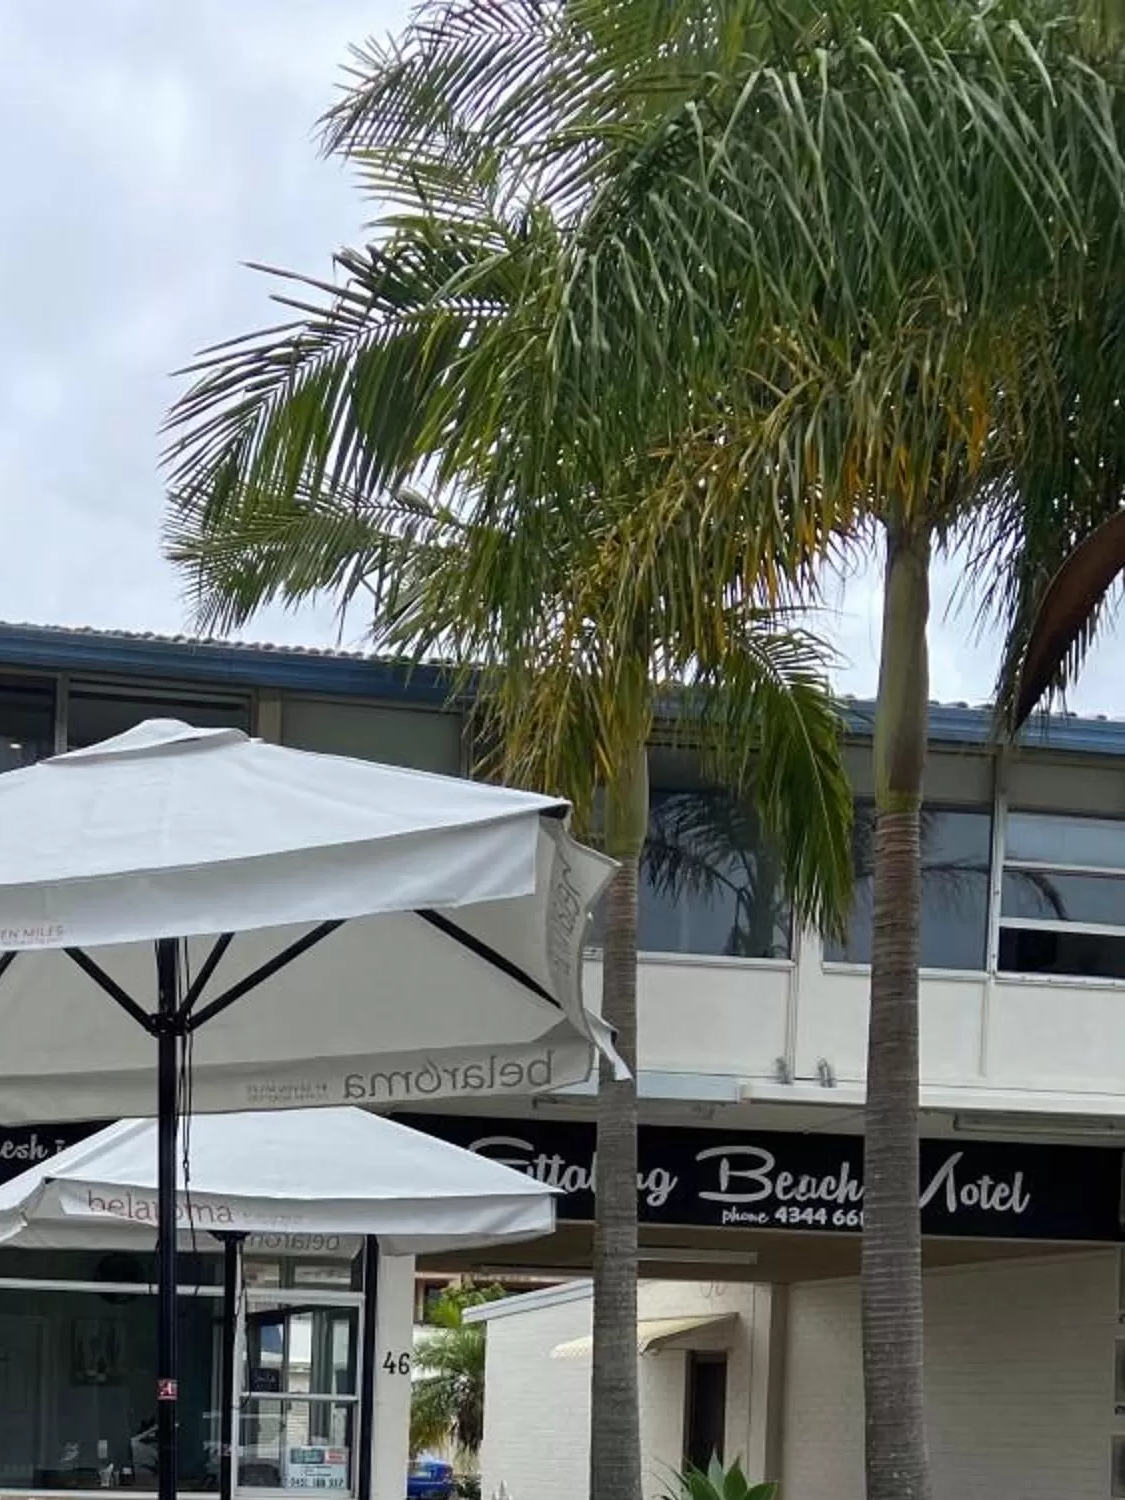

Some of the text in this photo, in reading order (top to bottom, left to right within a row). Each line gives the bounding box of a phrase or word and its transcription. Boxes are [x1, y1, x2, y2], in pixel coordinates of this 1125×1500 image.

[24, 925, 64, 938] MILES
[696, 1146, 865, 1204] Beach
[722, 1206, 770, 1225] phone
[774, 1207, 827, 1225] 4344
[383, 1352, 410, 1374] 46
